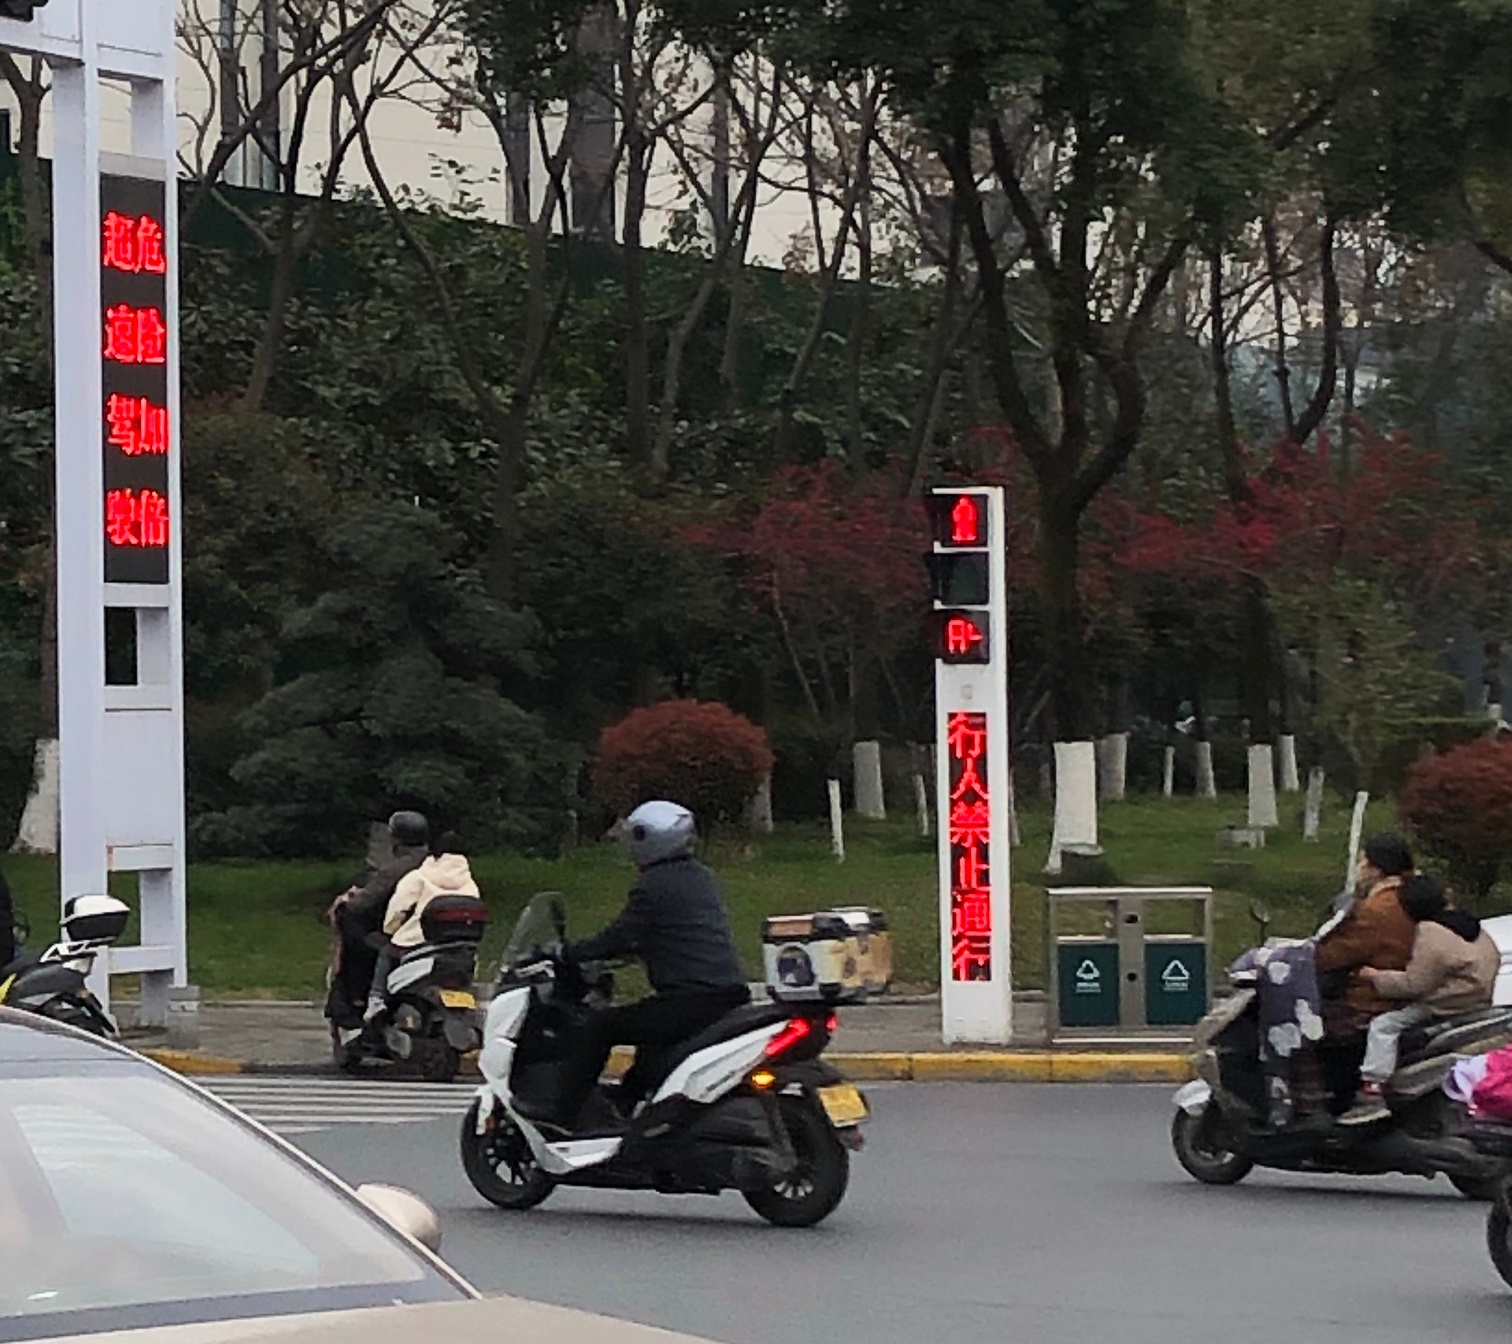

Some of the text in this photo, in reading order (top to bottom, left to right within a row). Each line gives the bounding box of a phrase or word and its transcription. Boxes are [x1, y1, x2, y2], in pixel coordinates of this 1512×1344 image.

[948, 713, 992, 981] 行人禁止通行
